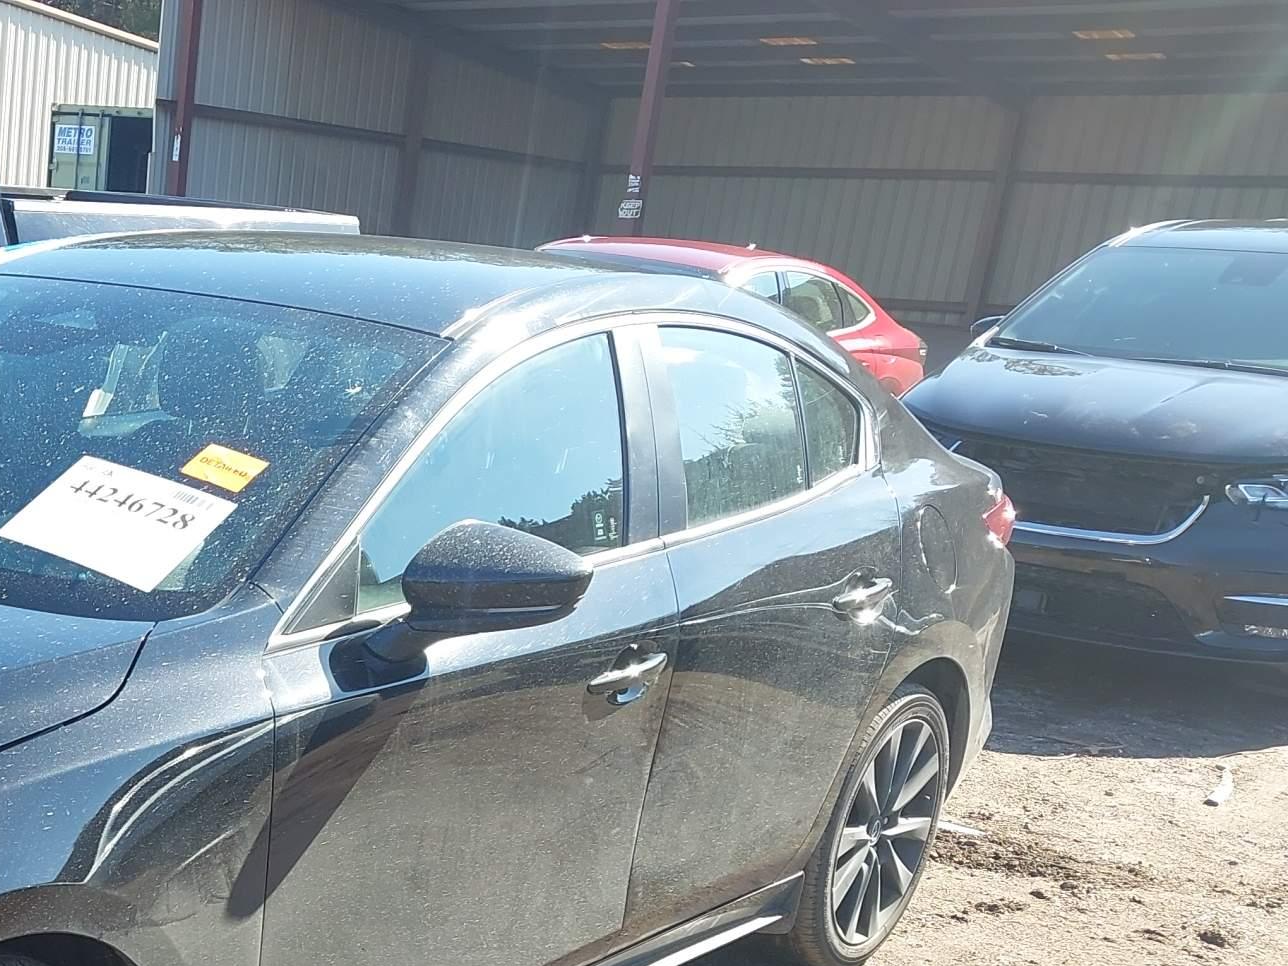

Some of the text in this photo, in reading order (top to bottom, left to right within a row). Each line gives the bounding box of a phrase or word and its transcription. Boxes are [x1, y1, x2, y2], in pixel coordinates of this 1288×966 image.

[58, 127, 93, 138] METRO
[56, 138, 92, 146] TRAIER
[70, 480, 196, 530] 44246728
